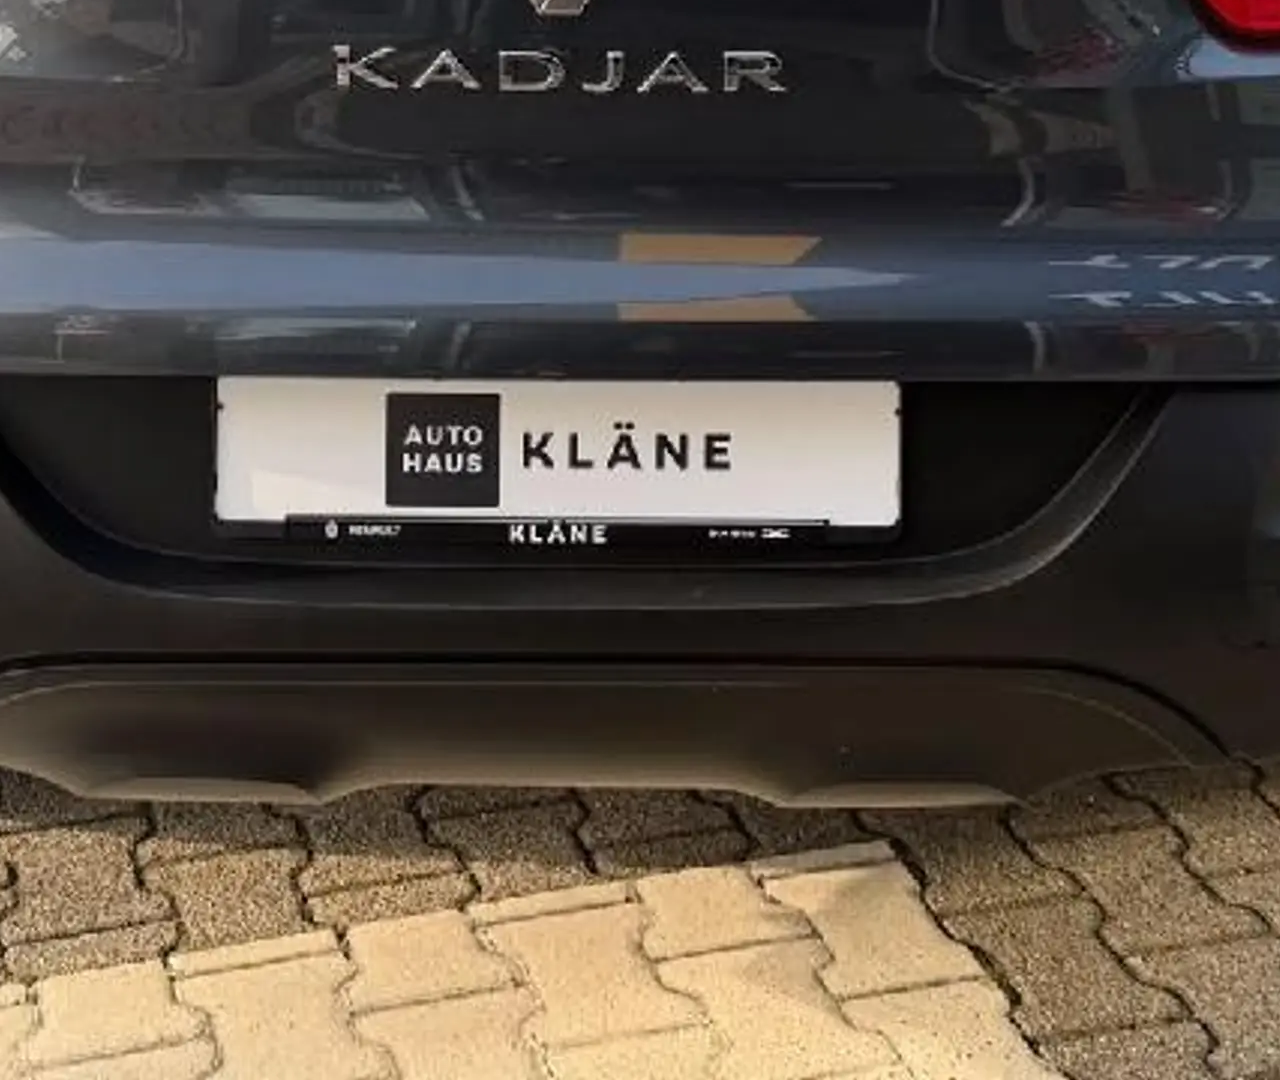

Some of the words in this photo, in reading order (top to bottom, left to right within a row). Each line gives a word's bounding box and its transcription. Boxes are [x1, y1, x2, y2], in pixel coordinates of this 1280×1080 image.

[332, 43, 786, 93] KADJAR
[402, 424, 483, 445] AUTO
[522, 421, 733, 471] KLÄNE
[401, 452, 483, 474] HAUS
